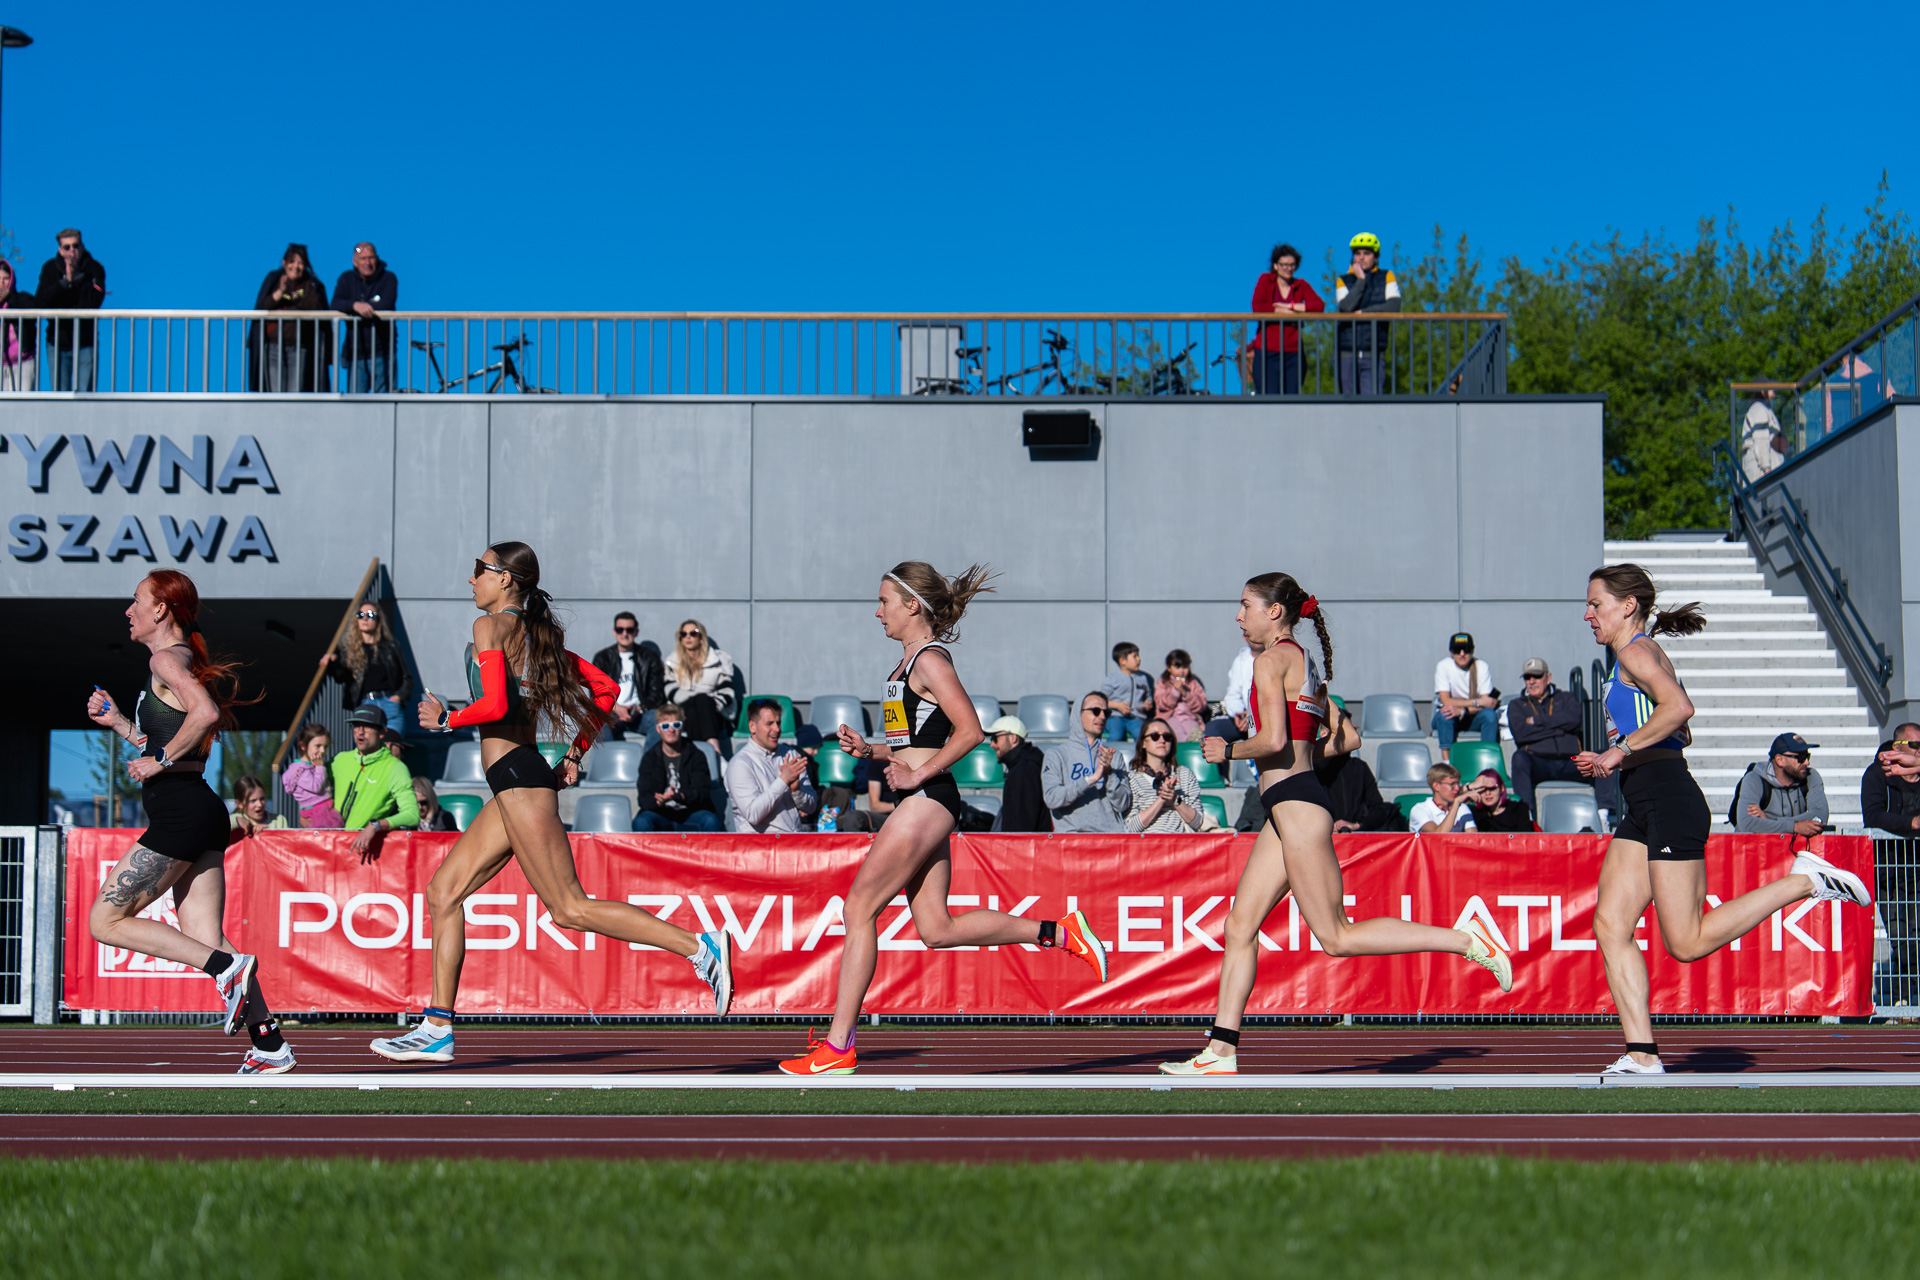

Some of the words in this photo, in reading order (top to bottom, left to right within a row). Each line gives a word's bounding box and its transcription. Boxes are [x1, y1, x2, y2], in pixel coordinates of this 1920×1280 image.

[0, 433, 281, 494] YWNA
[888, 685, 897, 698] 60
[1070, 762, 1096, 781] Be
[1452, 894, 1843, 952] ATLKI
